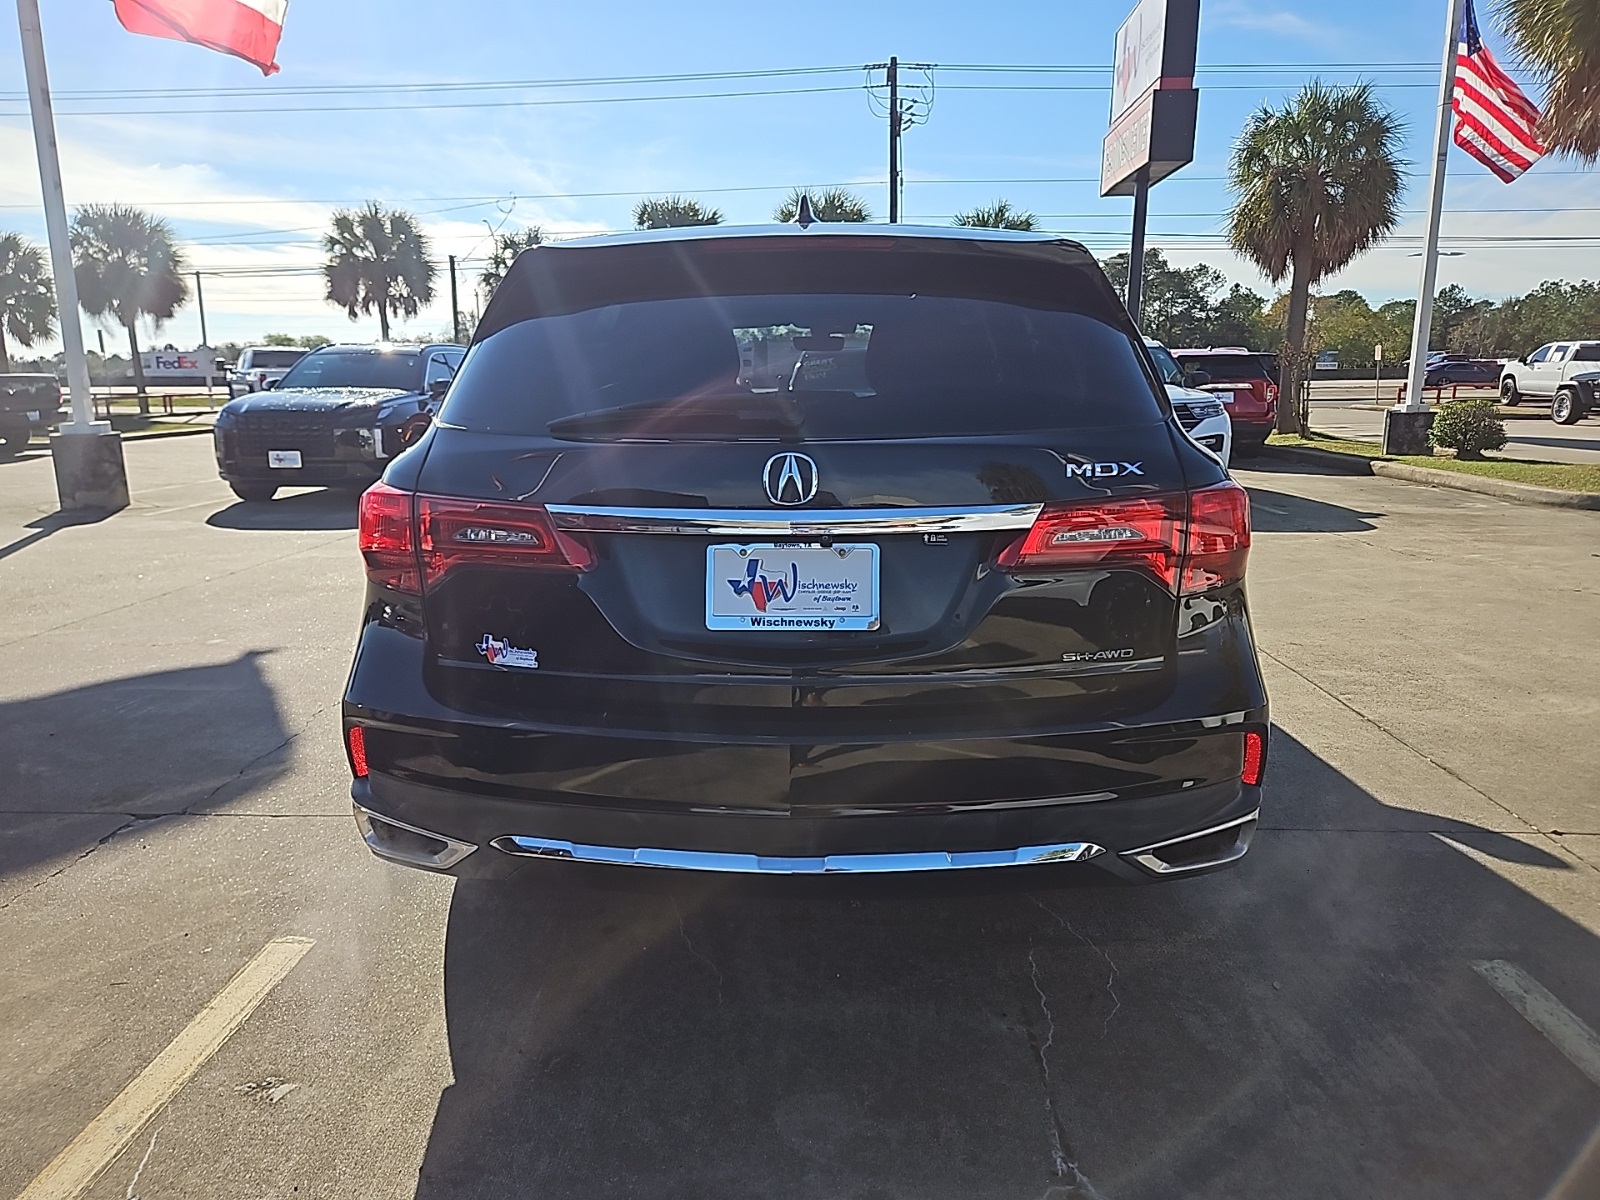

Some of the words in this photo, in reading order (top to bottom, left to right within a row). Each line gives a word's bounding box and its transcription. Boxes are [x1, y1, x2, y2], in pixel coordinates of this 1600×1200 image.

[156, 356, 199, 369] FedEx
[1066, 461, 1145, 478] MDX
[758, 562, 858, 604] Wischnewsky
[822, 595, 852, 603] Baytown
[750, 617, 836, 629] Wischnewsky
[1062, 648, 1135, 662] SH-AWD
